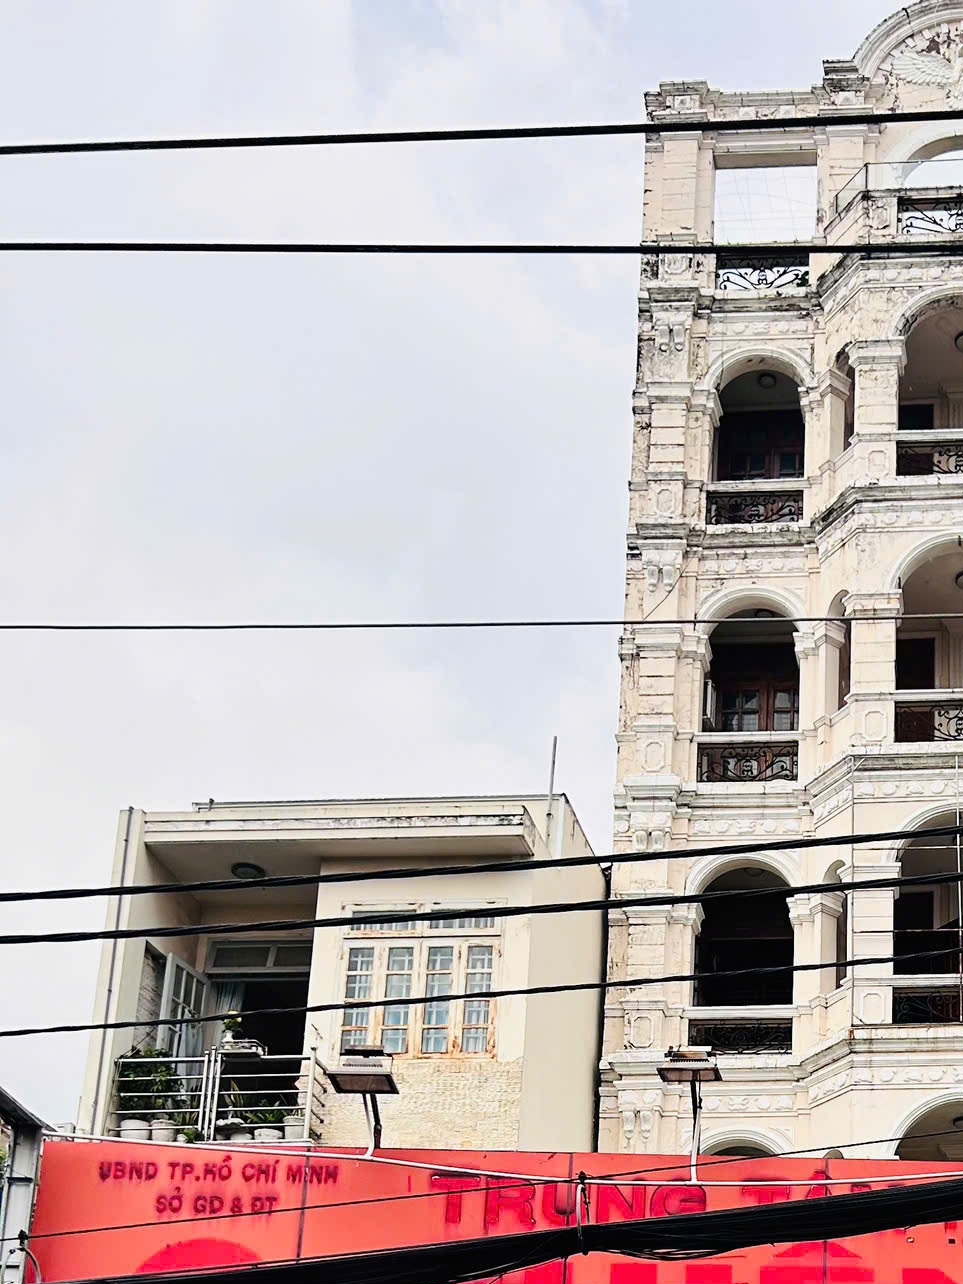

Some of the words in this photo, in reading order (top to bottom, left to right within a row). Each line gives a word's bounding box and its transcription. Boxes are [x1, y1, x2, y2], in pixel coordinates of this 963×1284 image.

[98, 1161, 158, 1182] UBND
[241, 1160, 280, 1184] CHÍ
[286, 1164, 340, 1185] MINH
[155, 1187, 183, 1214] SỞ
[193, 1195, 225, 1214] GD
[230, 1197, 244, 1214] &
[250, 1195, 279, 1216] ĐT
[430, 1174, 707, 1228] TRUNG
